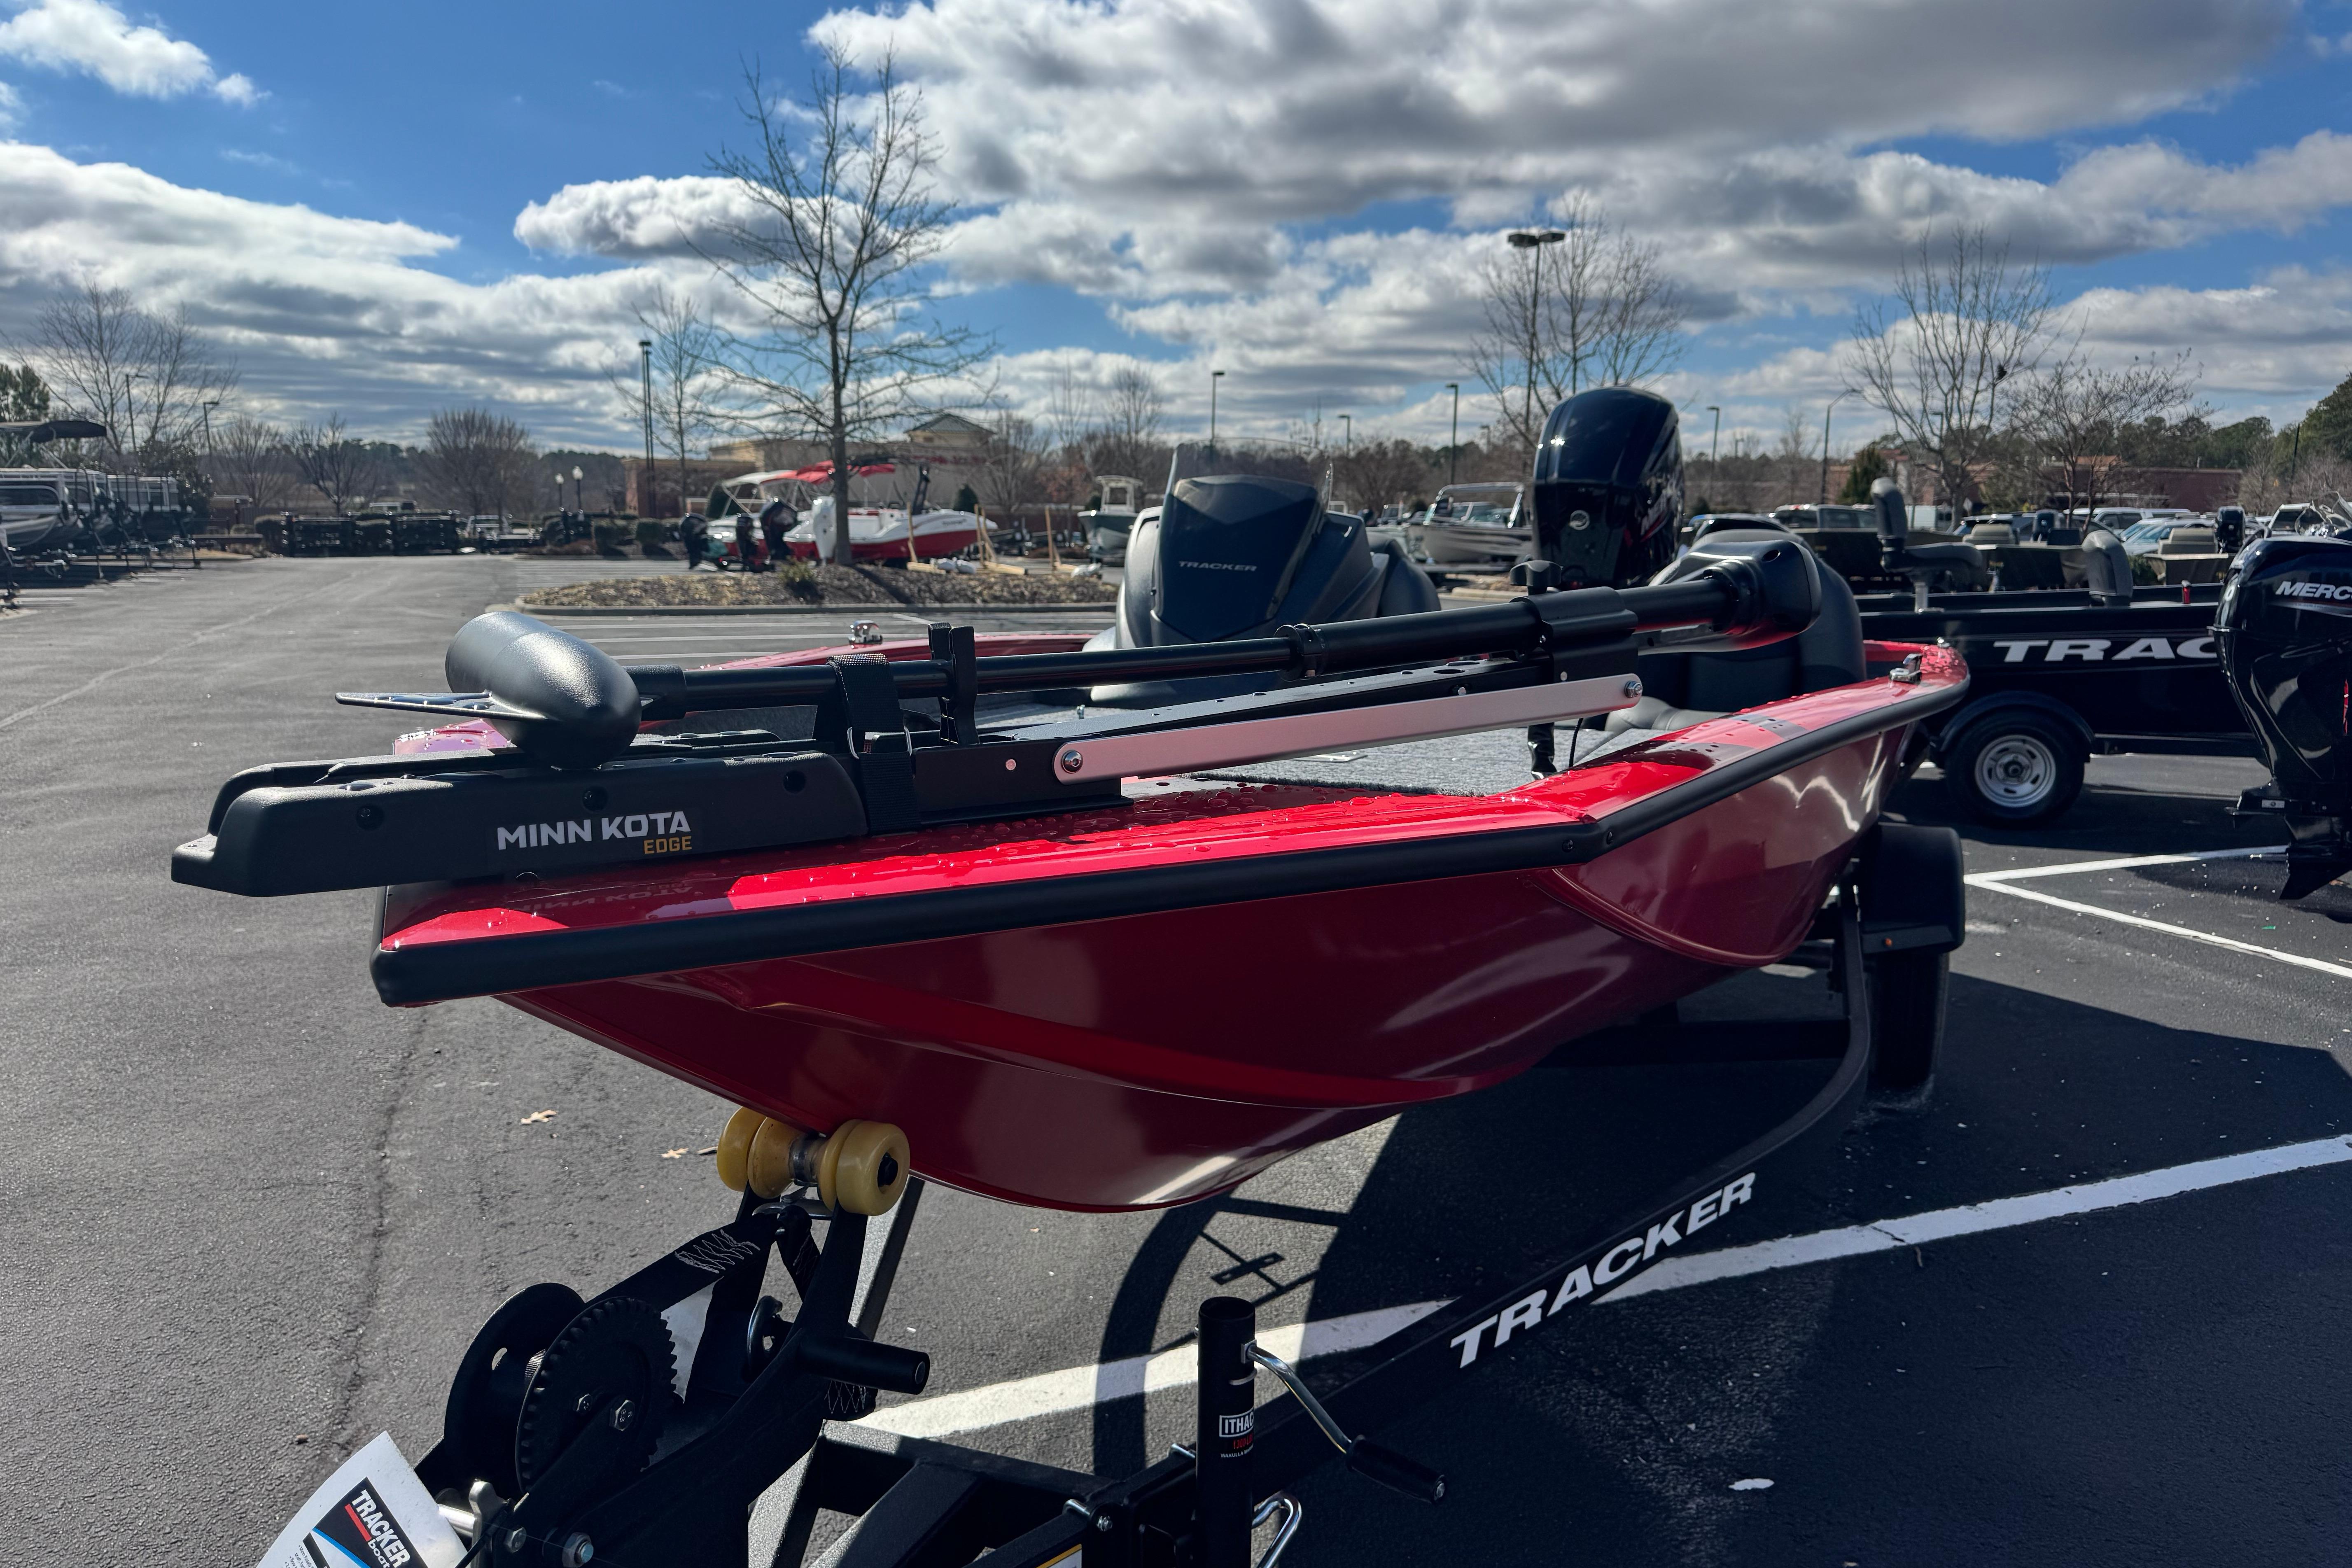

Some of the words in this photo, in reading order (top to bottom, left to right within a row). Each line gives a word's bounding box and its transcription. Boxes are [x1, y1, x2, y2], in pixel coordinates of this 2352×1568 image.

[1179, 561, 1257, 572] TRACKER
[2275, 581, 2352, 600] MERC
[497, 819, 593, 850] MINN
[601, 810, 691, 840] KOTA
[643, 835, 692, 854] EDGE
[1450, 1171, 1757, 1369] TRACKER
[352, 1489, 411, 1568] TRACKER
[367, 1538, 391, 1568] boat
